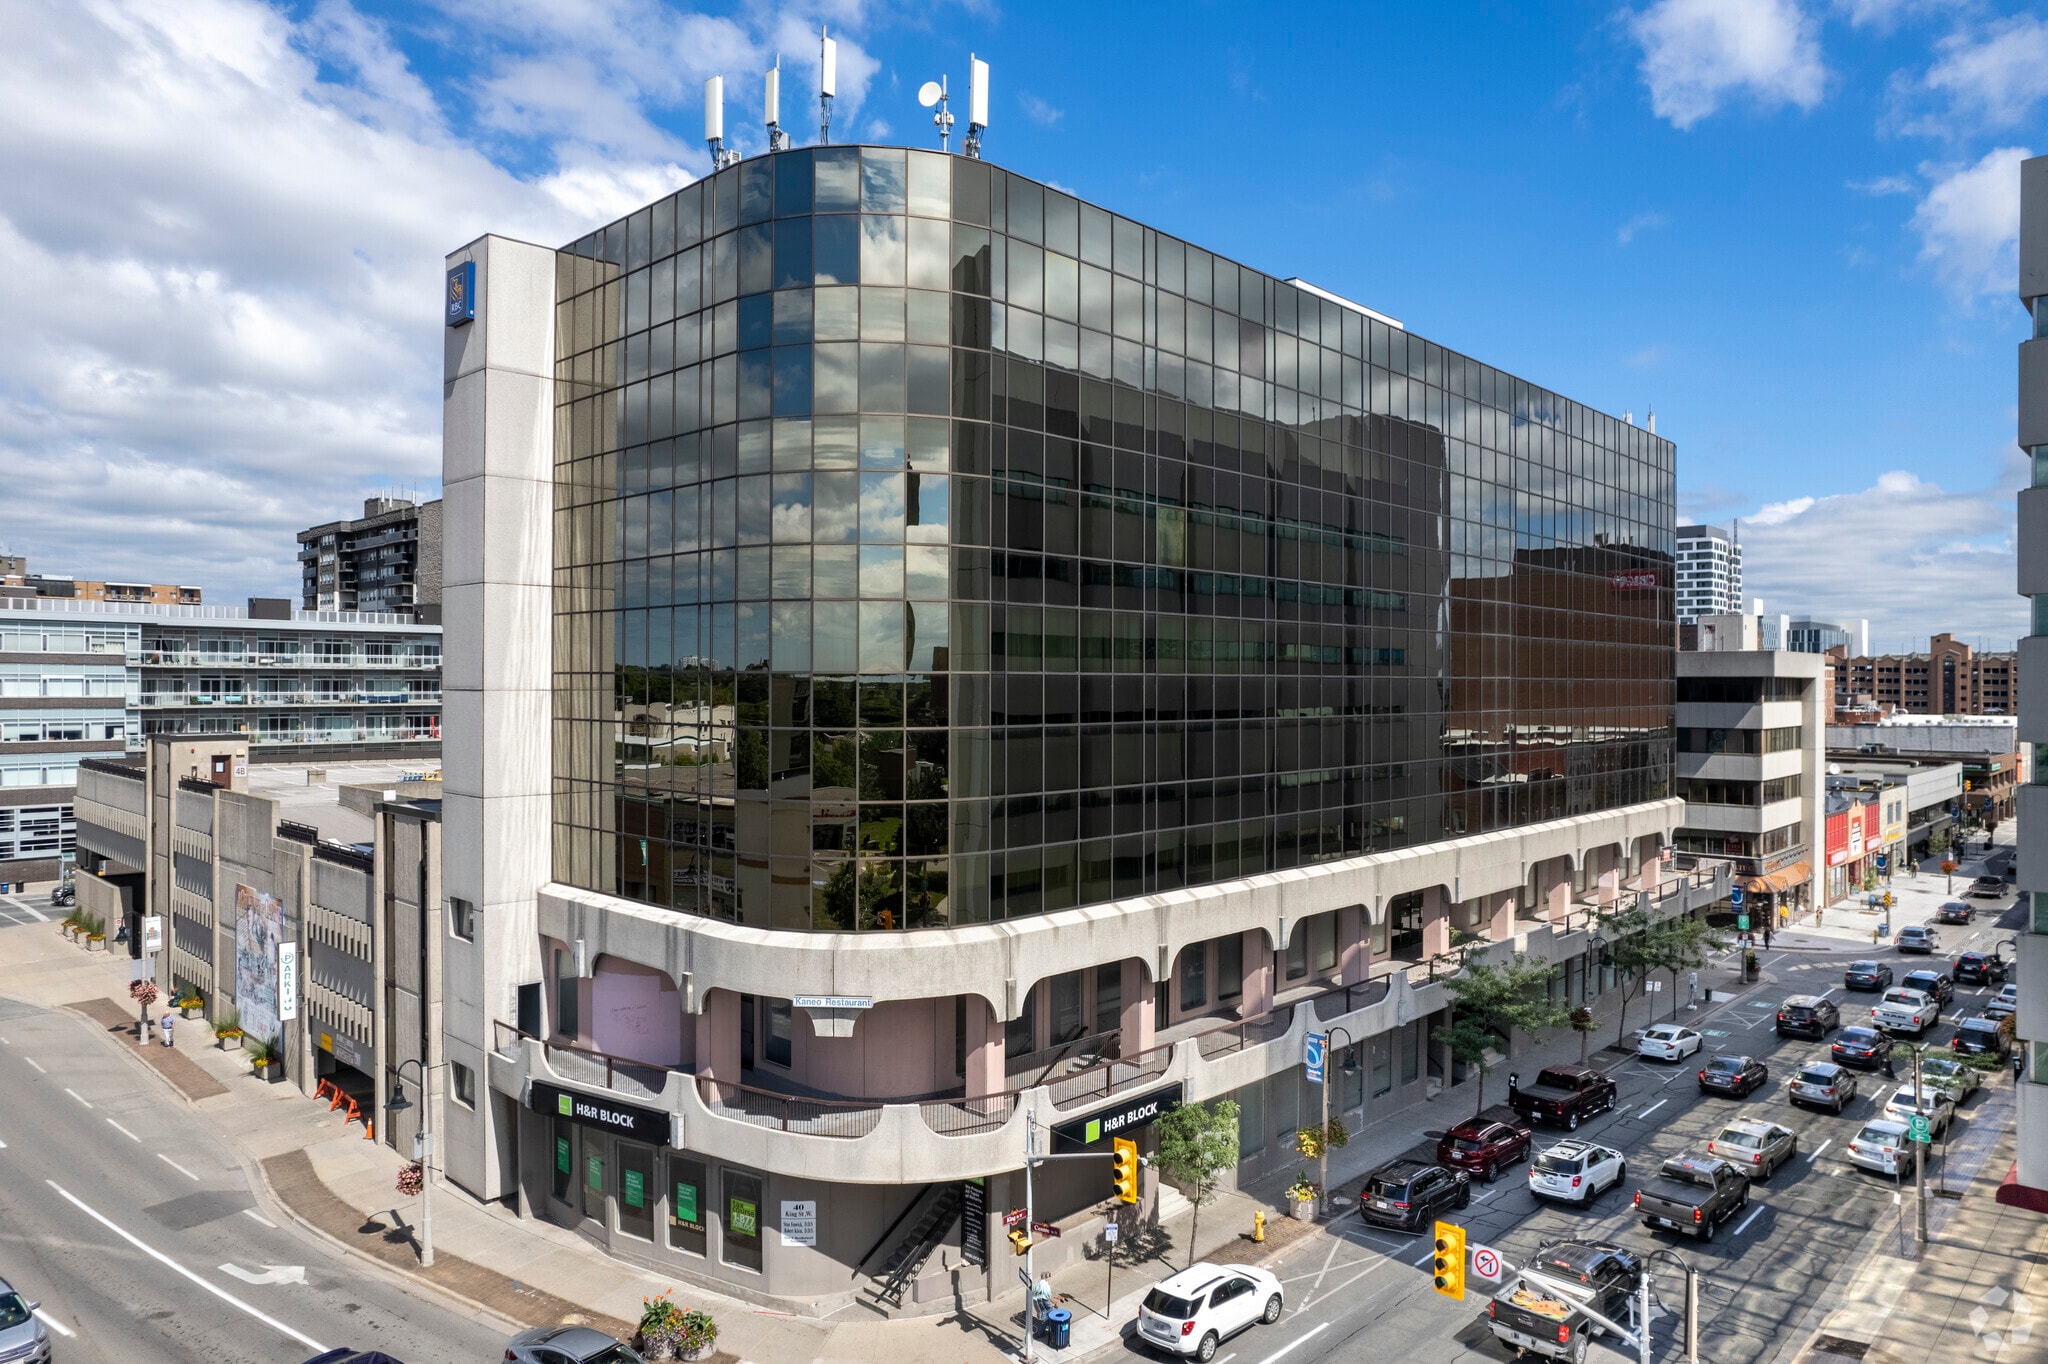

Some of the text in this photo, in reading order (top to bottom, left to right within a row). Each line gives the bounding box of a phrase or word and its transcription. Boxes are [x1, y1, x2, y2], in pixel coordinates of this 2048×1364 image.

[451, 300, 462, 312] RBC
[235, 767, 246, 775] 4B
[795, 996, 871, 1007] Kaneo Restaurant
[576, 1102, 634, 1129] H&R BLOCK
[1104, 1102, 1158, 1133] H&R BLOCK
[732, 1211, 755, 1226] 1-877
[677, 1220, 706, 1233] H&R BLOCK
